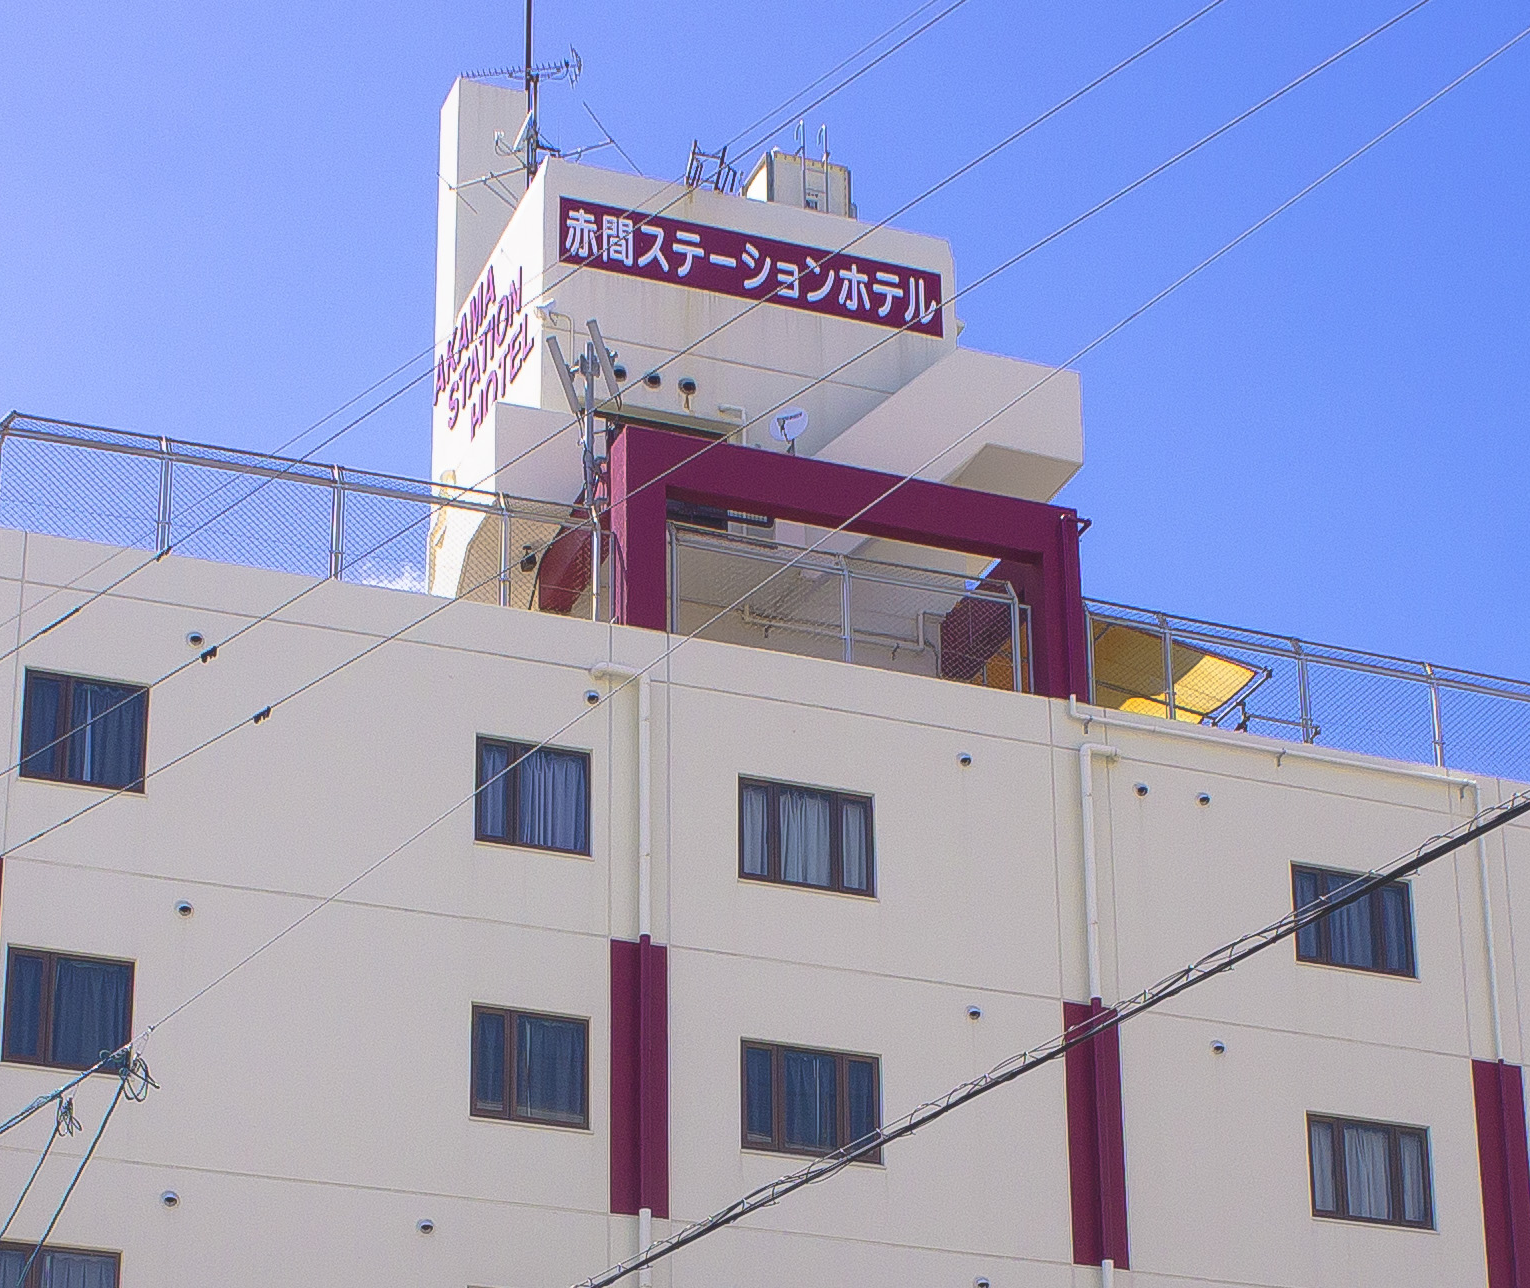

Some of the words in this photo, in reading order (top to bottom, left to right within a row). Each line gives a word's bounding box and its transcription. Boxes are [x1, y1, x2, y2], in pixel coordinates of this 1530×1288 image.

[565, 208, 937, 325] 赤間ステーションホテル
[432, 264, 497, 407] AKAMA
[448, 265, 523, 431] STATION
[470, 313, 535, 443] HOTEL
